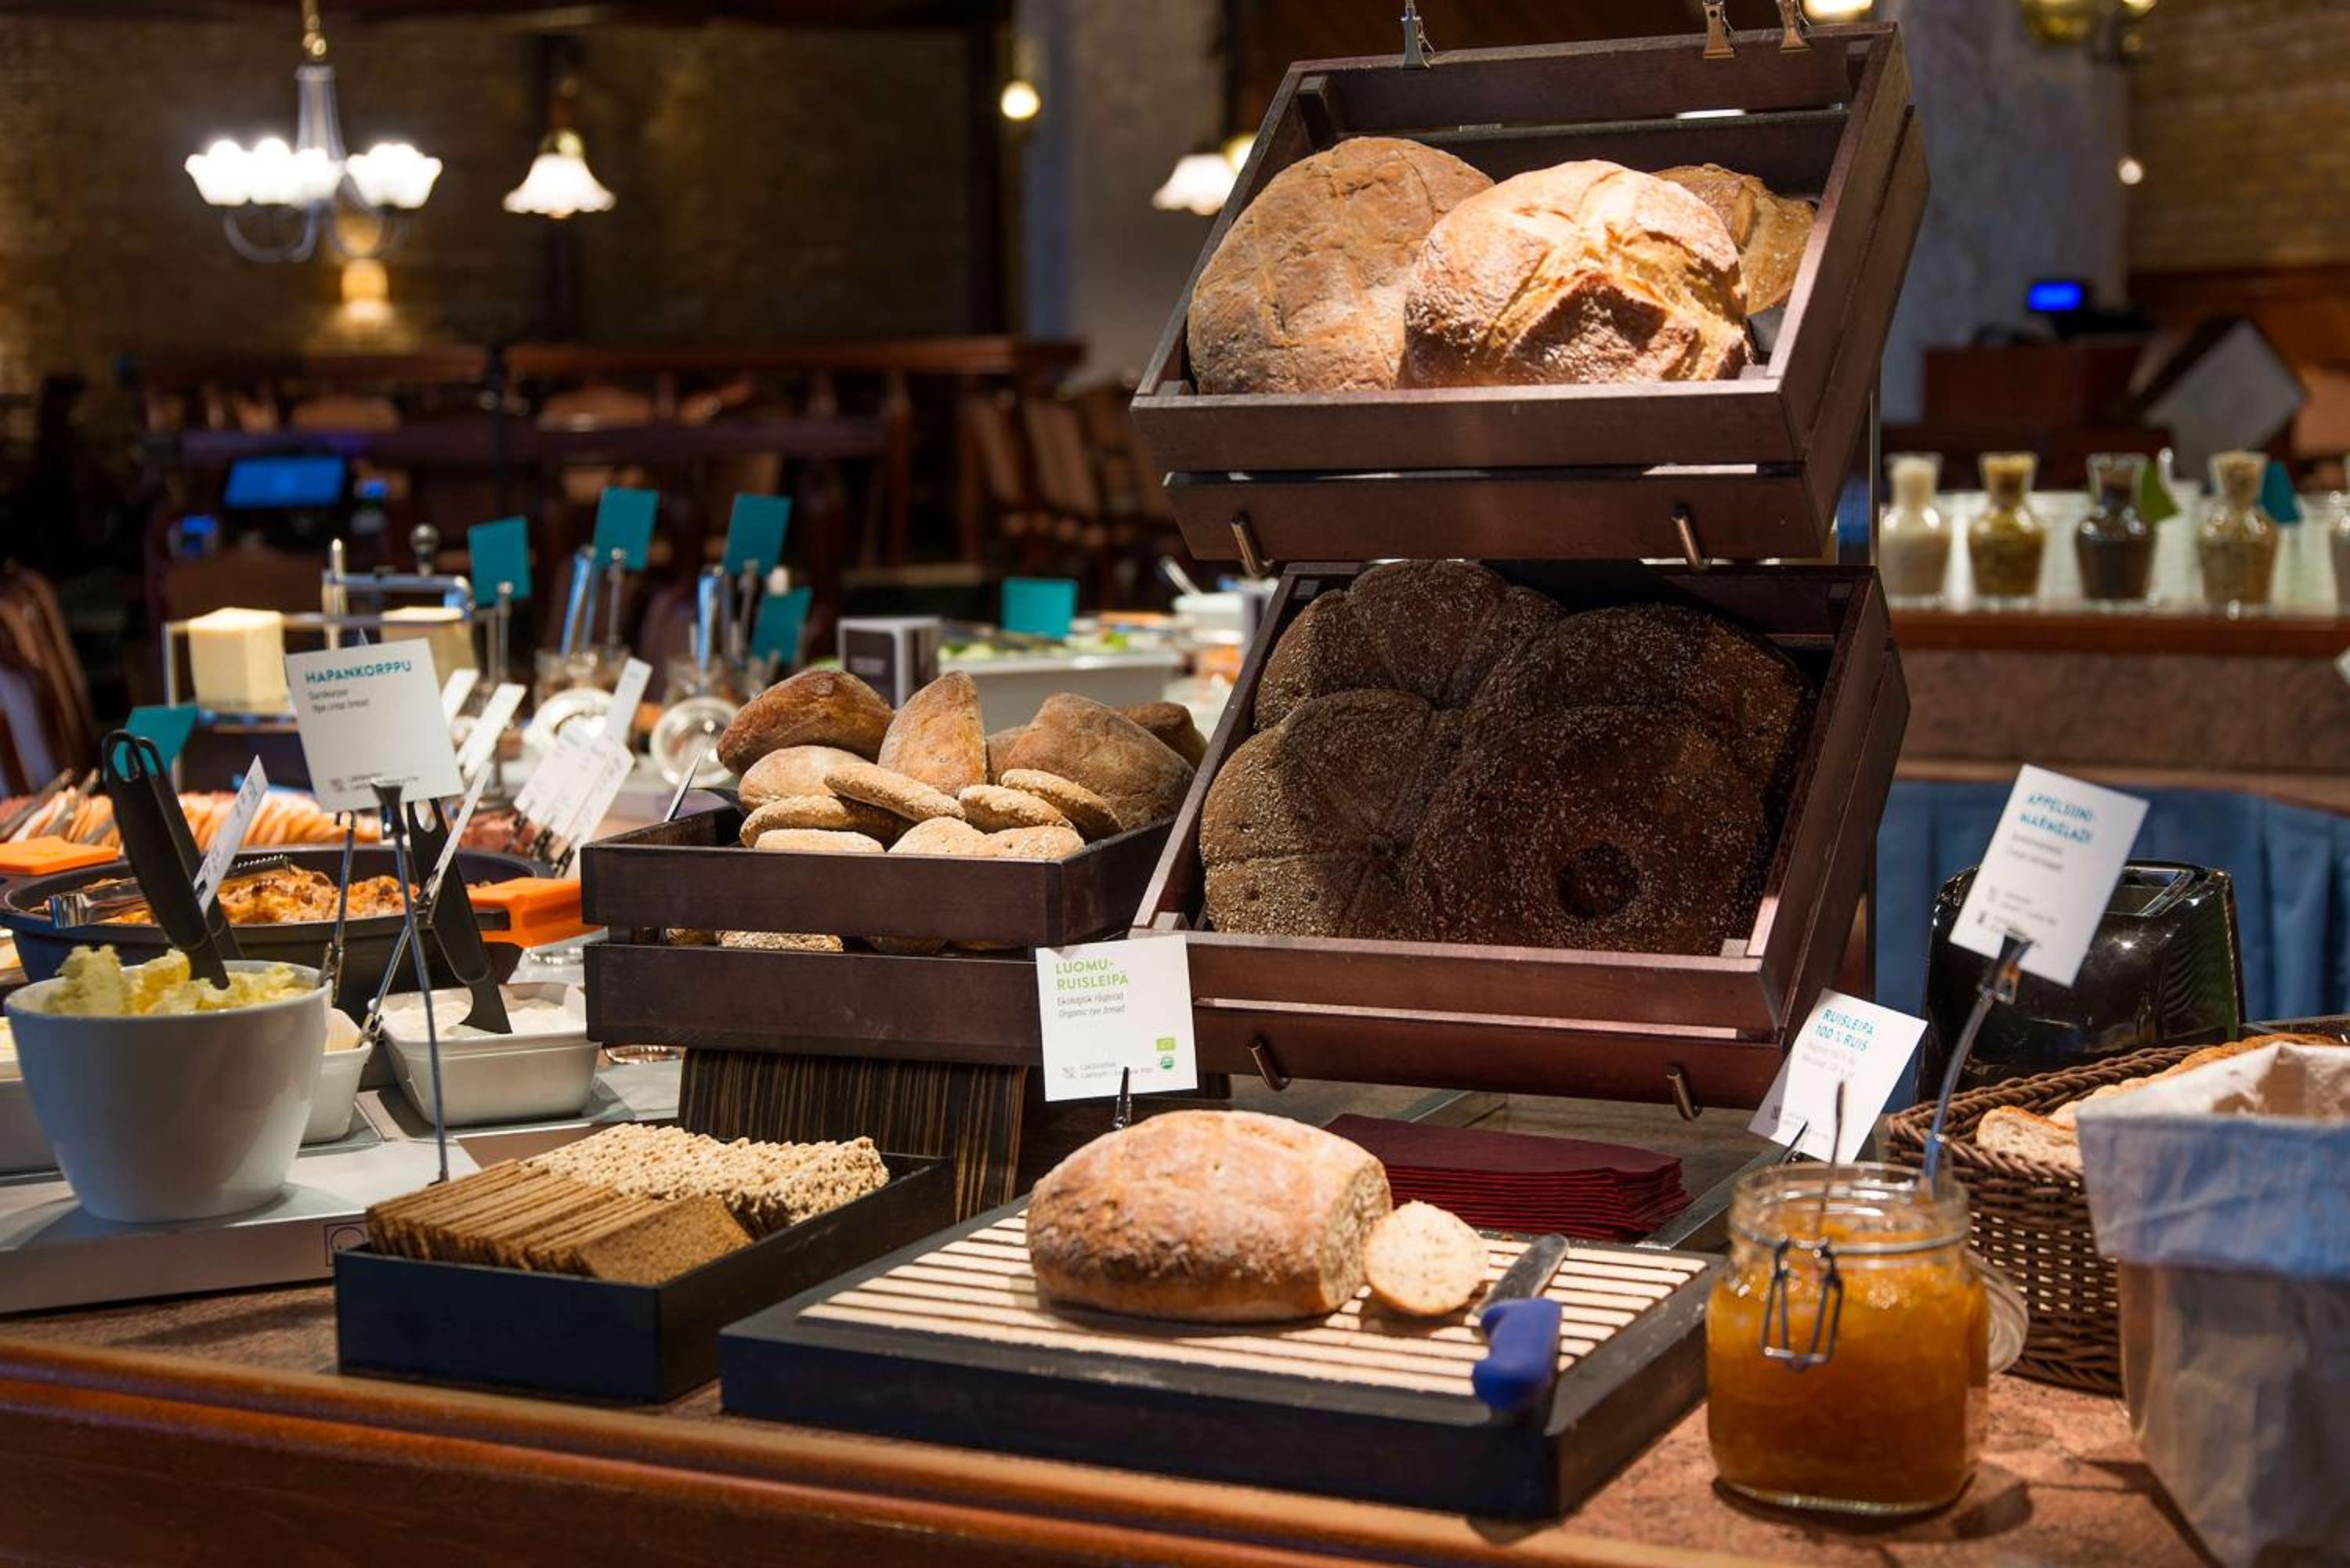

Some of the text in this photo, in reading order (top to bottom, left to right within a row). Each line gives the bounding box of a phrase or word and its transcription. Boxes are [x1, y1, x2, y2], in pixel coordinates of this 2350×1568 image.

[305, 660, 411, 683] HAPANKORPPU
[1055, 958, 1113, 974] LUOMU-
[1817, 1024, 1834, 1040] 100
[1842, 1034, 1869, 1052] RUIS
